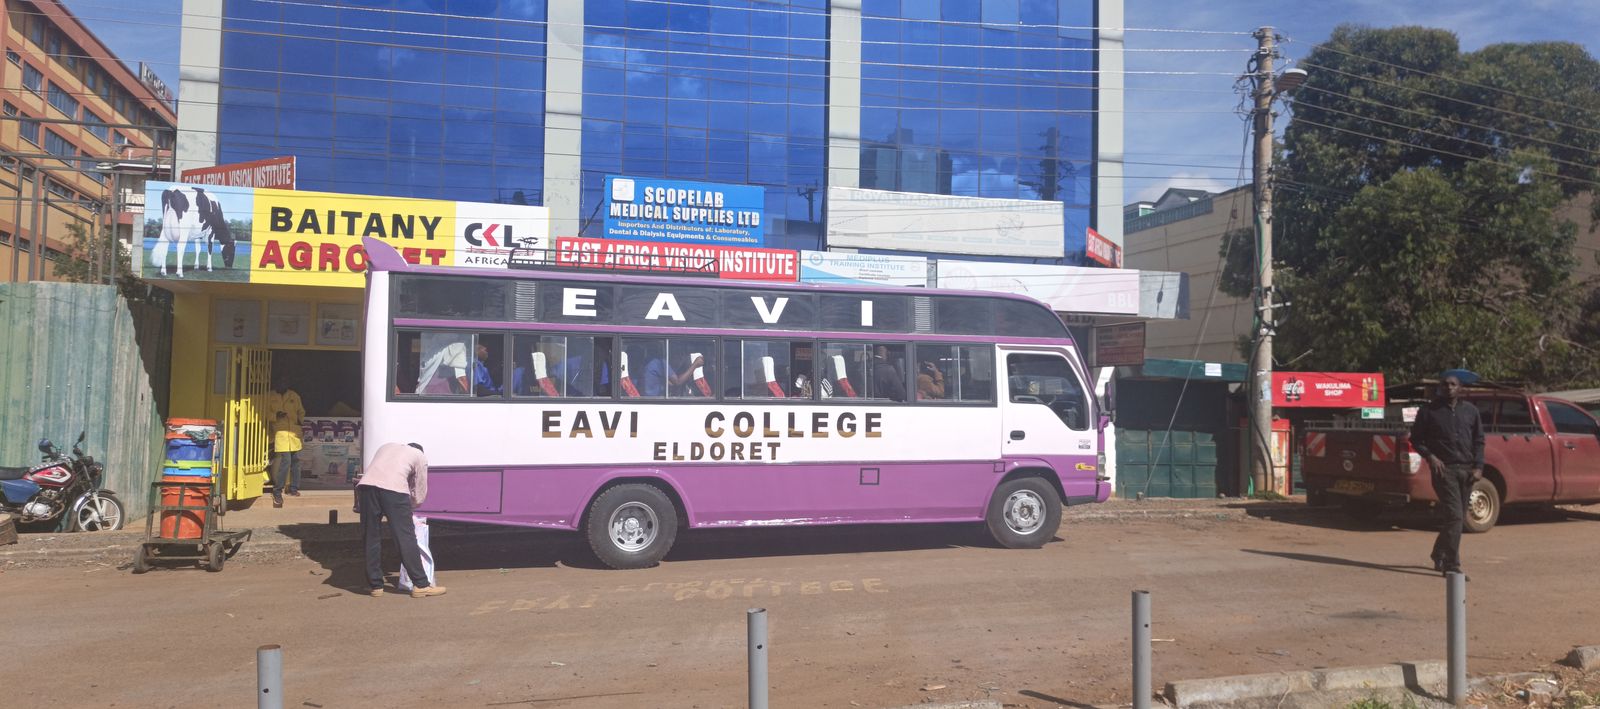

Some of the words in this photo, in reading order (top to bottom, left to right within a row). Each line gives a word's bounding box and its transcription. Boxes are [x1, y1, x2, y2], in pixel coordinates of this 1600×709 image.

[229, 168, 253, 188] VISION
[254, 163, 291, 187] INSTITUTE
[644, 186, 724, 208] SCOPELAB
[269, 206, 442, 241] BAITANY
[610, 203, 669, 221] MEDICAL
[673, 207, 734, 225] SUPPLIES
[738, 211, 760, 227] LTD
[618, 221, 650, 230] Importers
[666, 223, 704, 232] Distributors
[464, 222, 521, 248] CKL
[609, 228, 631, 236] Dental
[640, 229, 665, 238] Dialysis
[667, 231, 705, 240] Equipments
[259, 240, 447, 271] AGROET
[560, 241, 602, 263] EAST
[605, 243, 661, 267] AFRICA
[664, 246, 715, 270] VISION
[720, 250, 794, 275] INSTITUTE
[830, 260, 865, 268] TRAINING
[867, 262, 905, 271] INSTITUTE
[847, 254, 890, 263] MEDIPLUS
[1315, 382, 1352, 390] WAKULIMA
[541, 410, 639, 438] EAVI
[704, 411, 882, 439] COLLEGE
[653, 441, 781, 461] ELDORET
